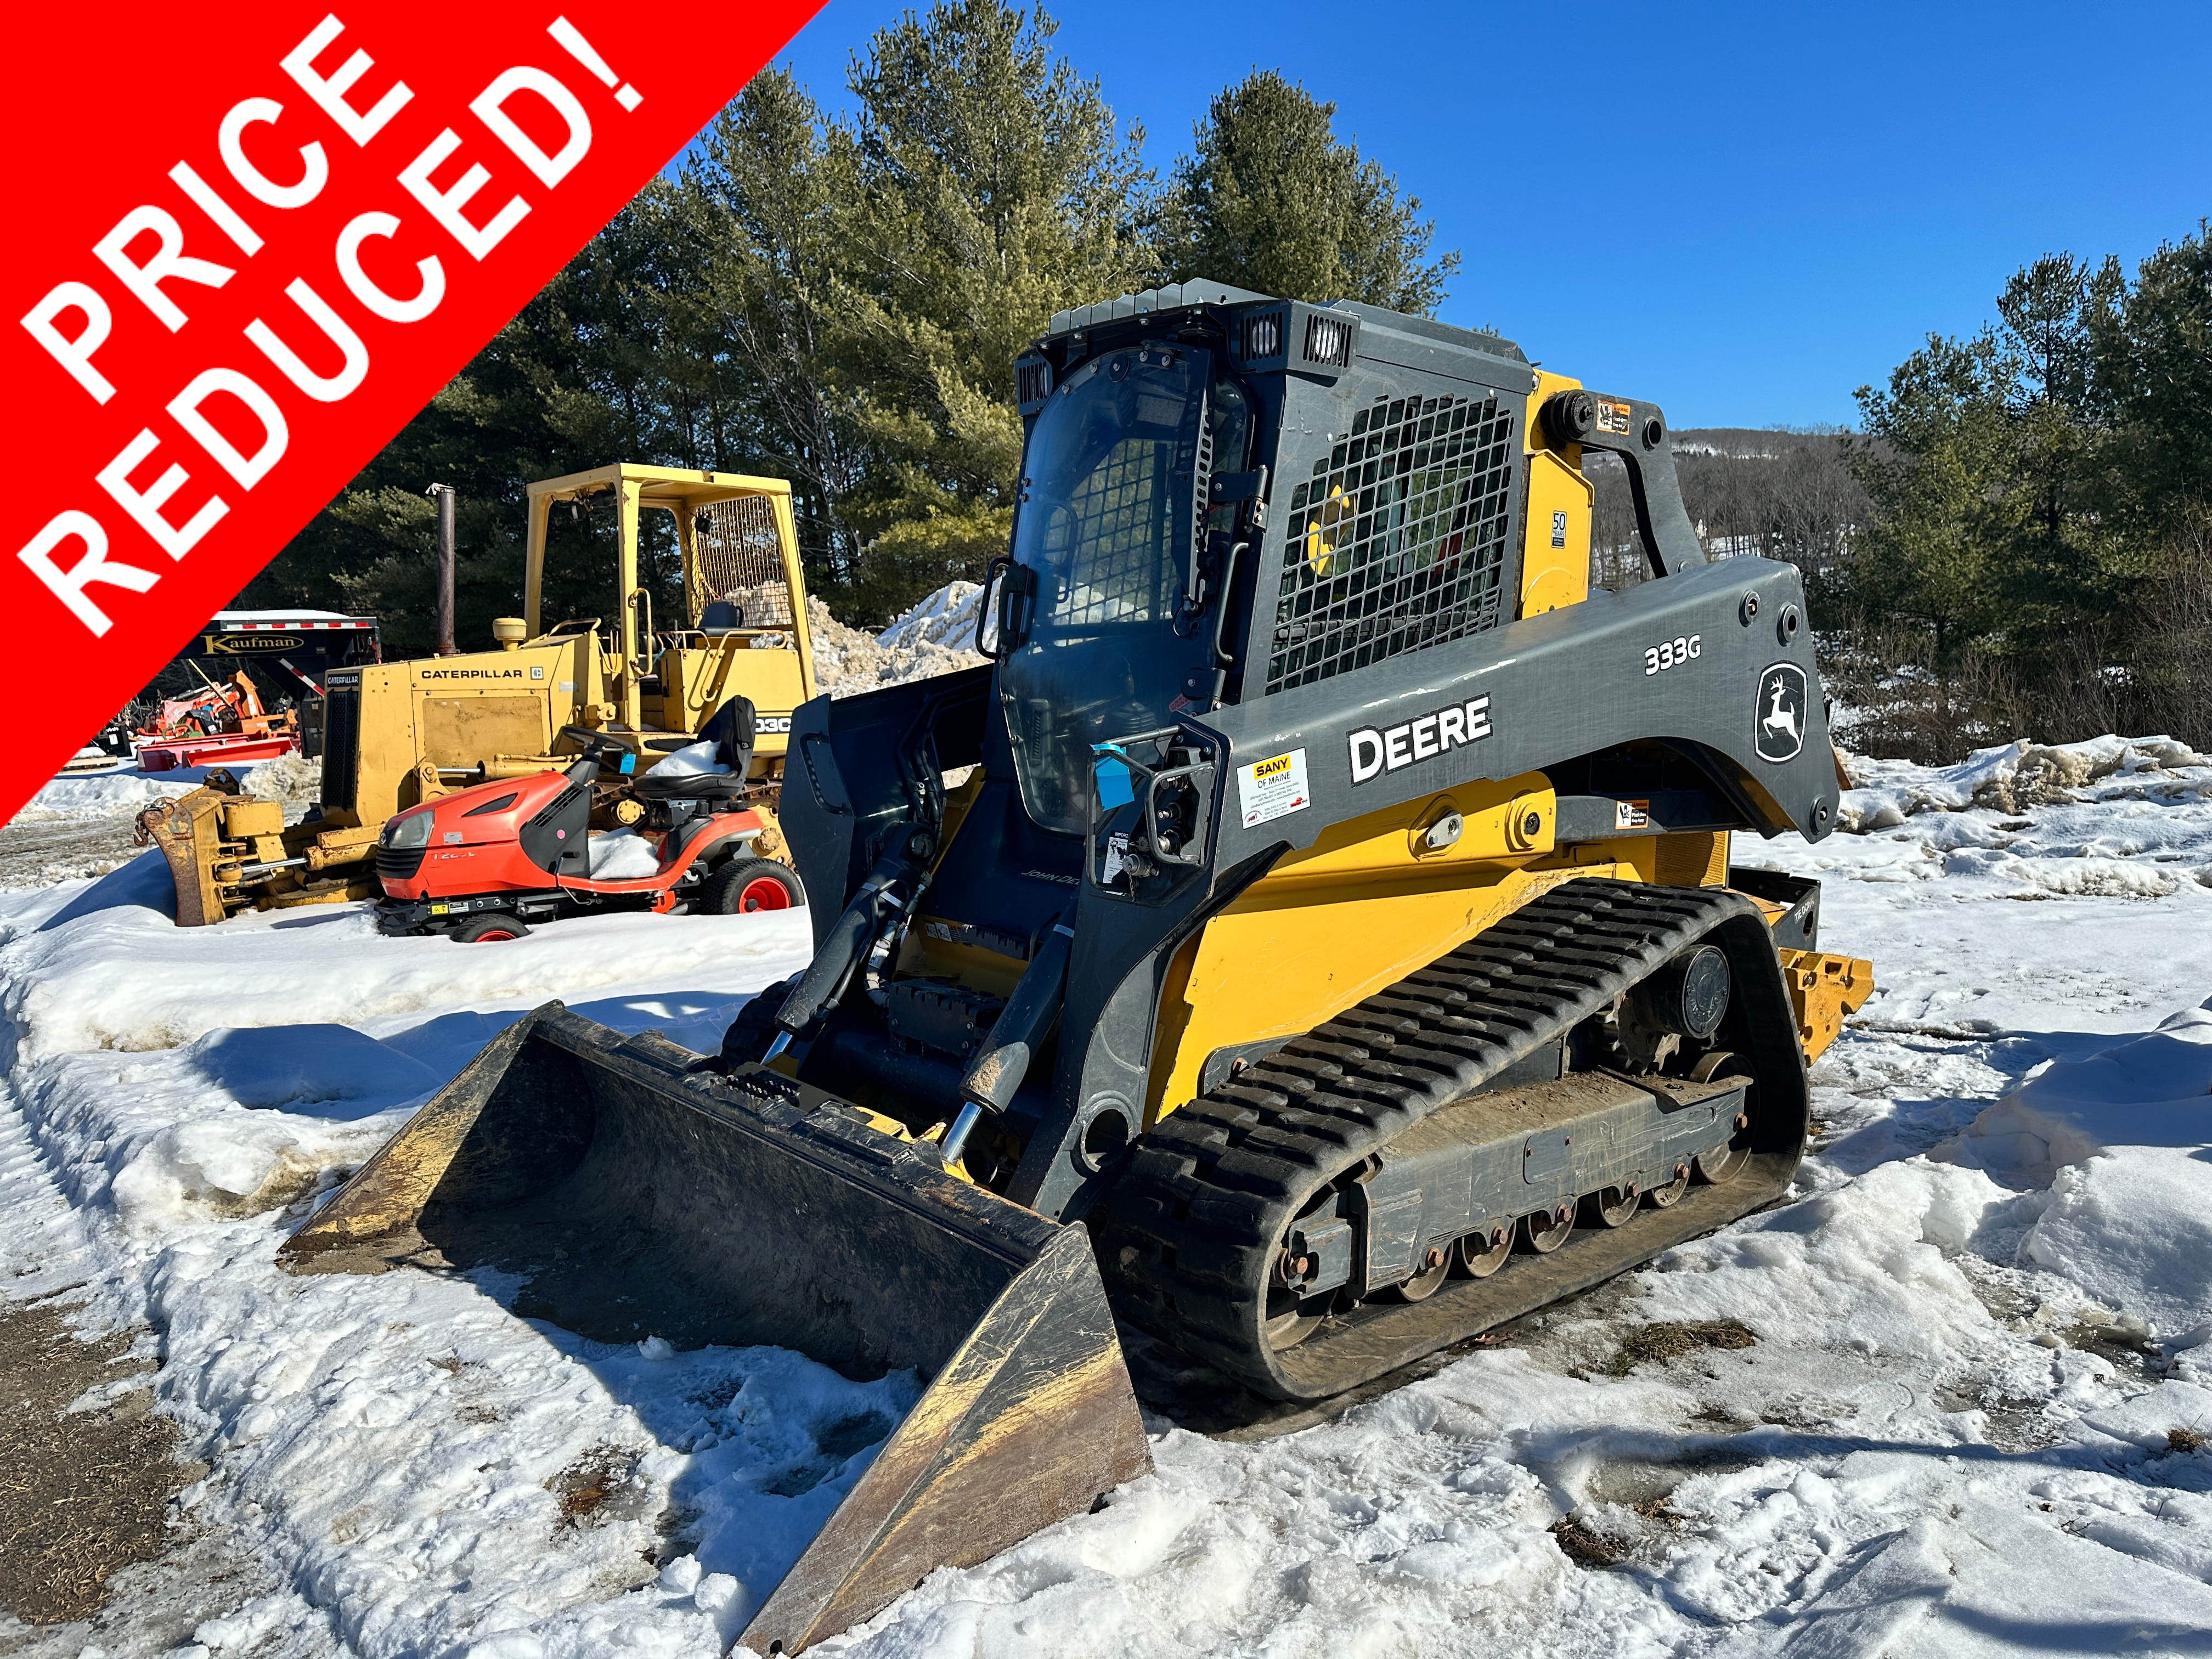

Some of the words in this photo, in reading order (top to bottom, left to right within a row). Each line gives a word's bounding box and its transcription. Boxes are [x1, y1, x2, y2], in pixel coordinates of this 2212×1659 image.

[1553, 513, 1565, 530] 50
[200, 635, 295, 654] Kaufman
[1645, 635, 1700, 675] 333G
[328, 676, 358, 684] CATERPILLAR
[1349, 696, 1491, 783] DEERE
[1257, 758, 1288, 777] SANY
[1257, 779, 1267, 788] OF
[1268, 771, 1291, 785] MAINE
[1021, 870, 1060, 881] JOHN
[1802, 896, 1814, 915] DOWN
